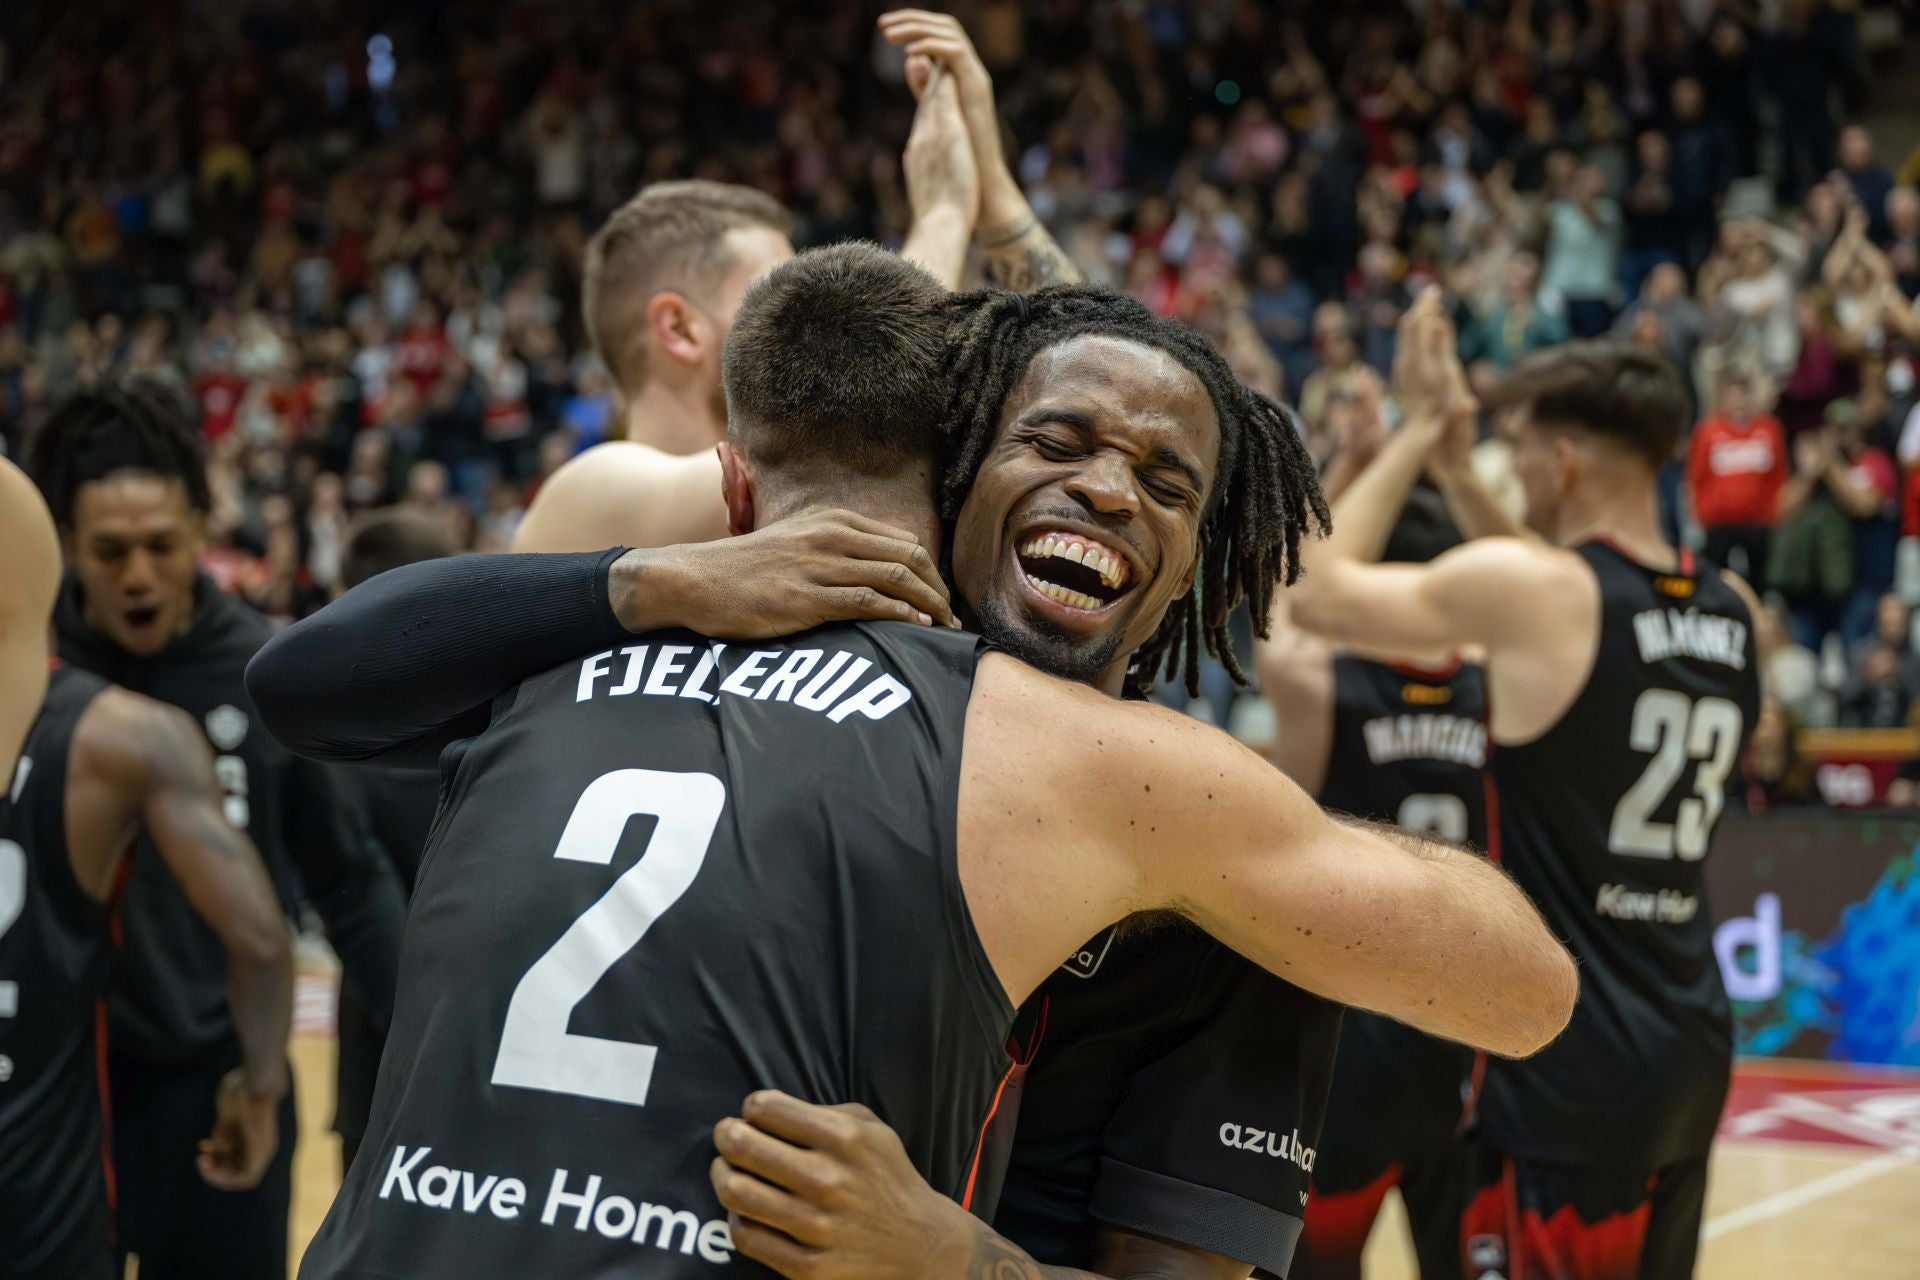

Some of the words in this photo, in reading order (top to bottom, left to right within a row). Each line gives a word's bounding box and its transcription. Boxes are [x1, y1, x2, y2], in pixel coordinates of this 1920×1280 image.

[1608, 688, 1743, 861] 23
[491, 768, 726, 1106] 2
[379, 1145, 527, 1219] Kave
[540, 1168, 736, 1264] Home
[1219, 1122, 1316, 1173] azula
